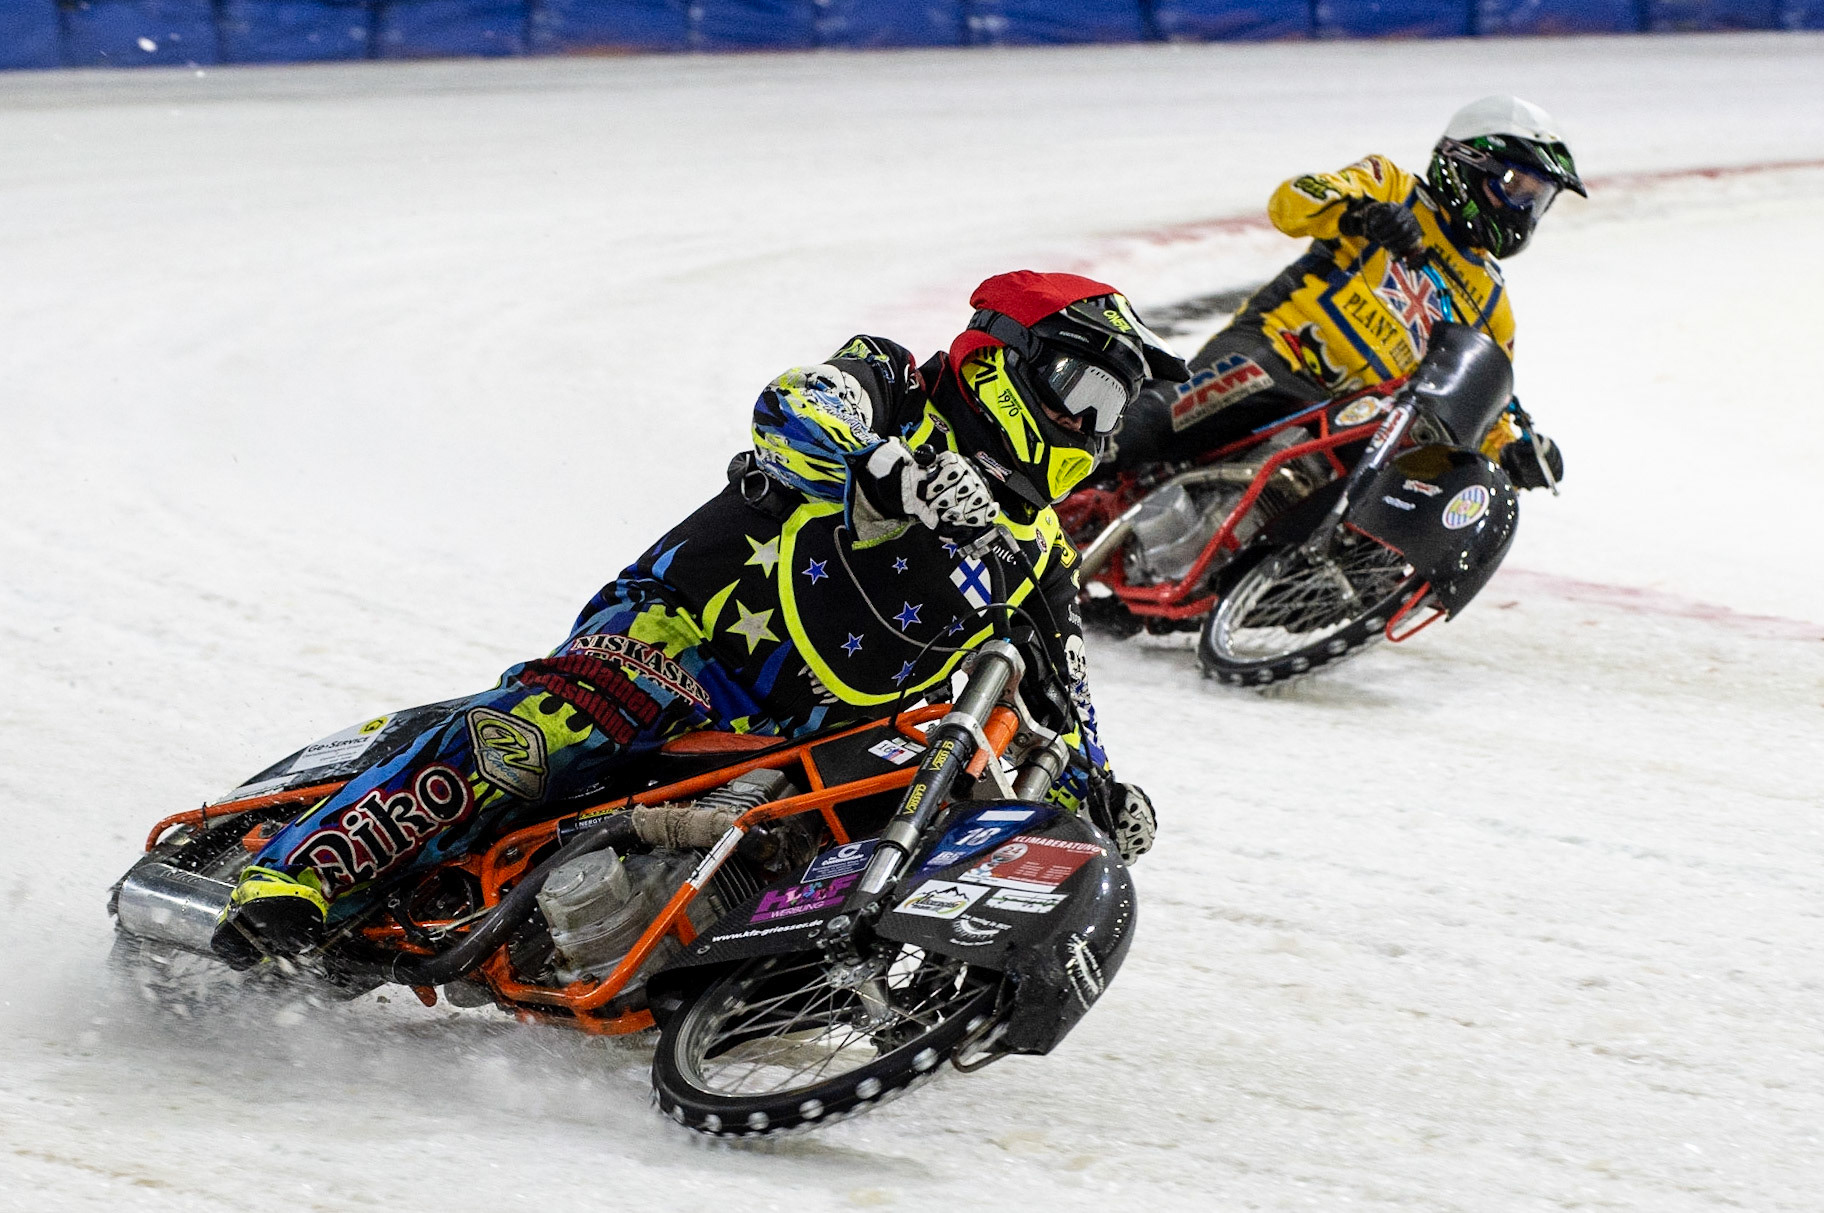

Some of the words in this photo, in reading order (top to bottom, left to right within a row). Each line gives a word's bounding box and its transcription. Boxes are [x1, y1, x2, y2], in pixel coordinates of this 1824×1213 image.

[1343, 292, 1397, 346] PLANT
[998, 390, 1019, 417] 1970
[771, 901, 825, 918] WERBUNG
